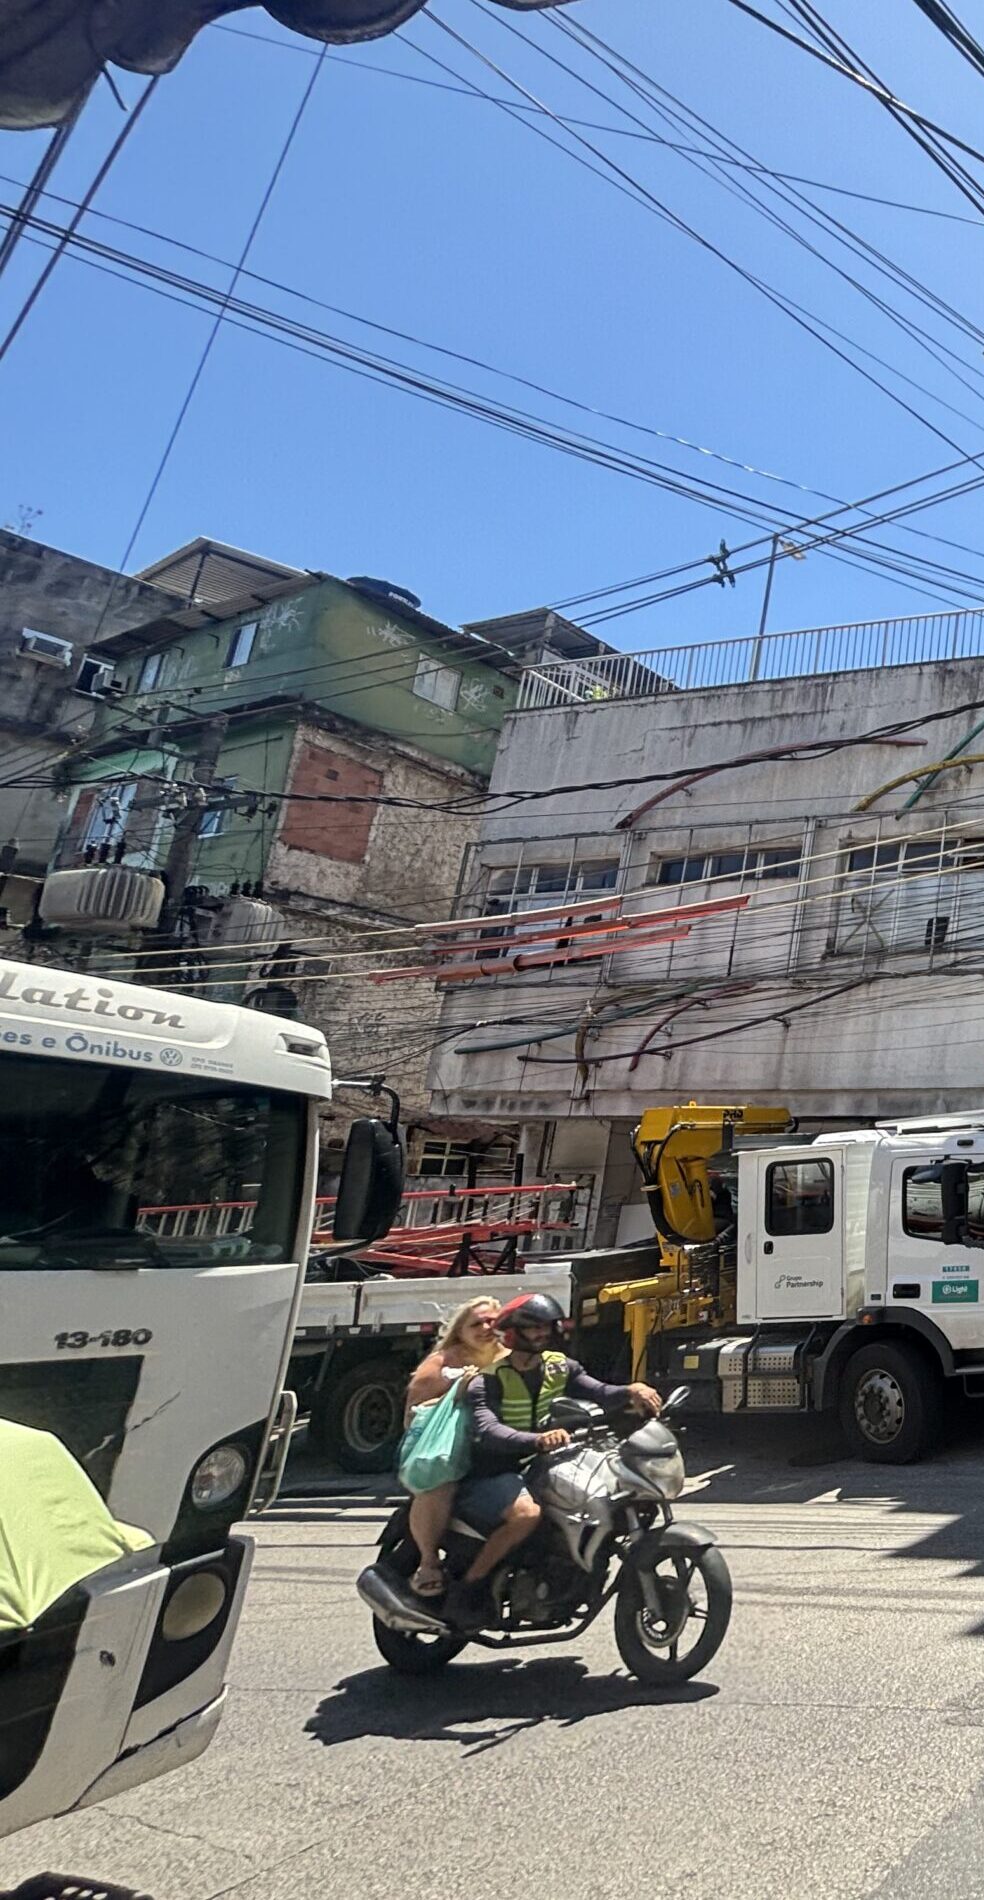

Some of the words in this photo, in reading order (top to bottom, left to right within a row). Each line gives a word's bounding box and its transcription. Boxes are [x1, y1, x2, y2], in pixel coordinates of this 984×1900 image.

[42, 1036, 57, 1048] e
[66, 1033, 153, 1062] Ônibus
[786, 1280, 824, 1288] Partnership
[54, 1328, 153, 1349] 13-180
